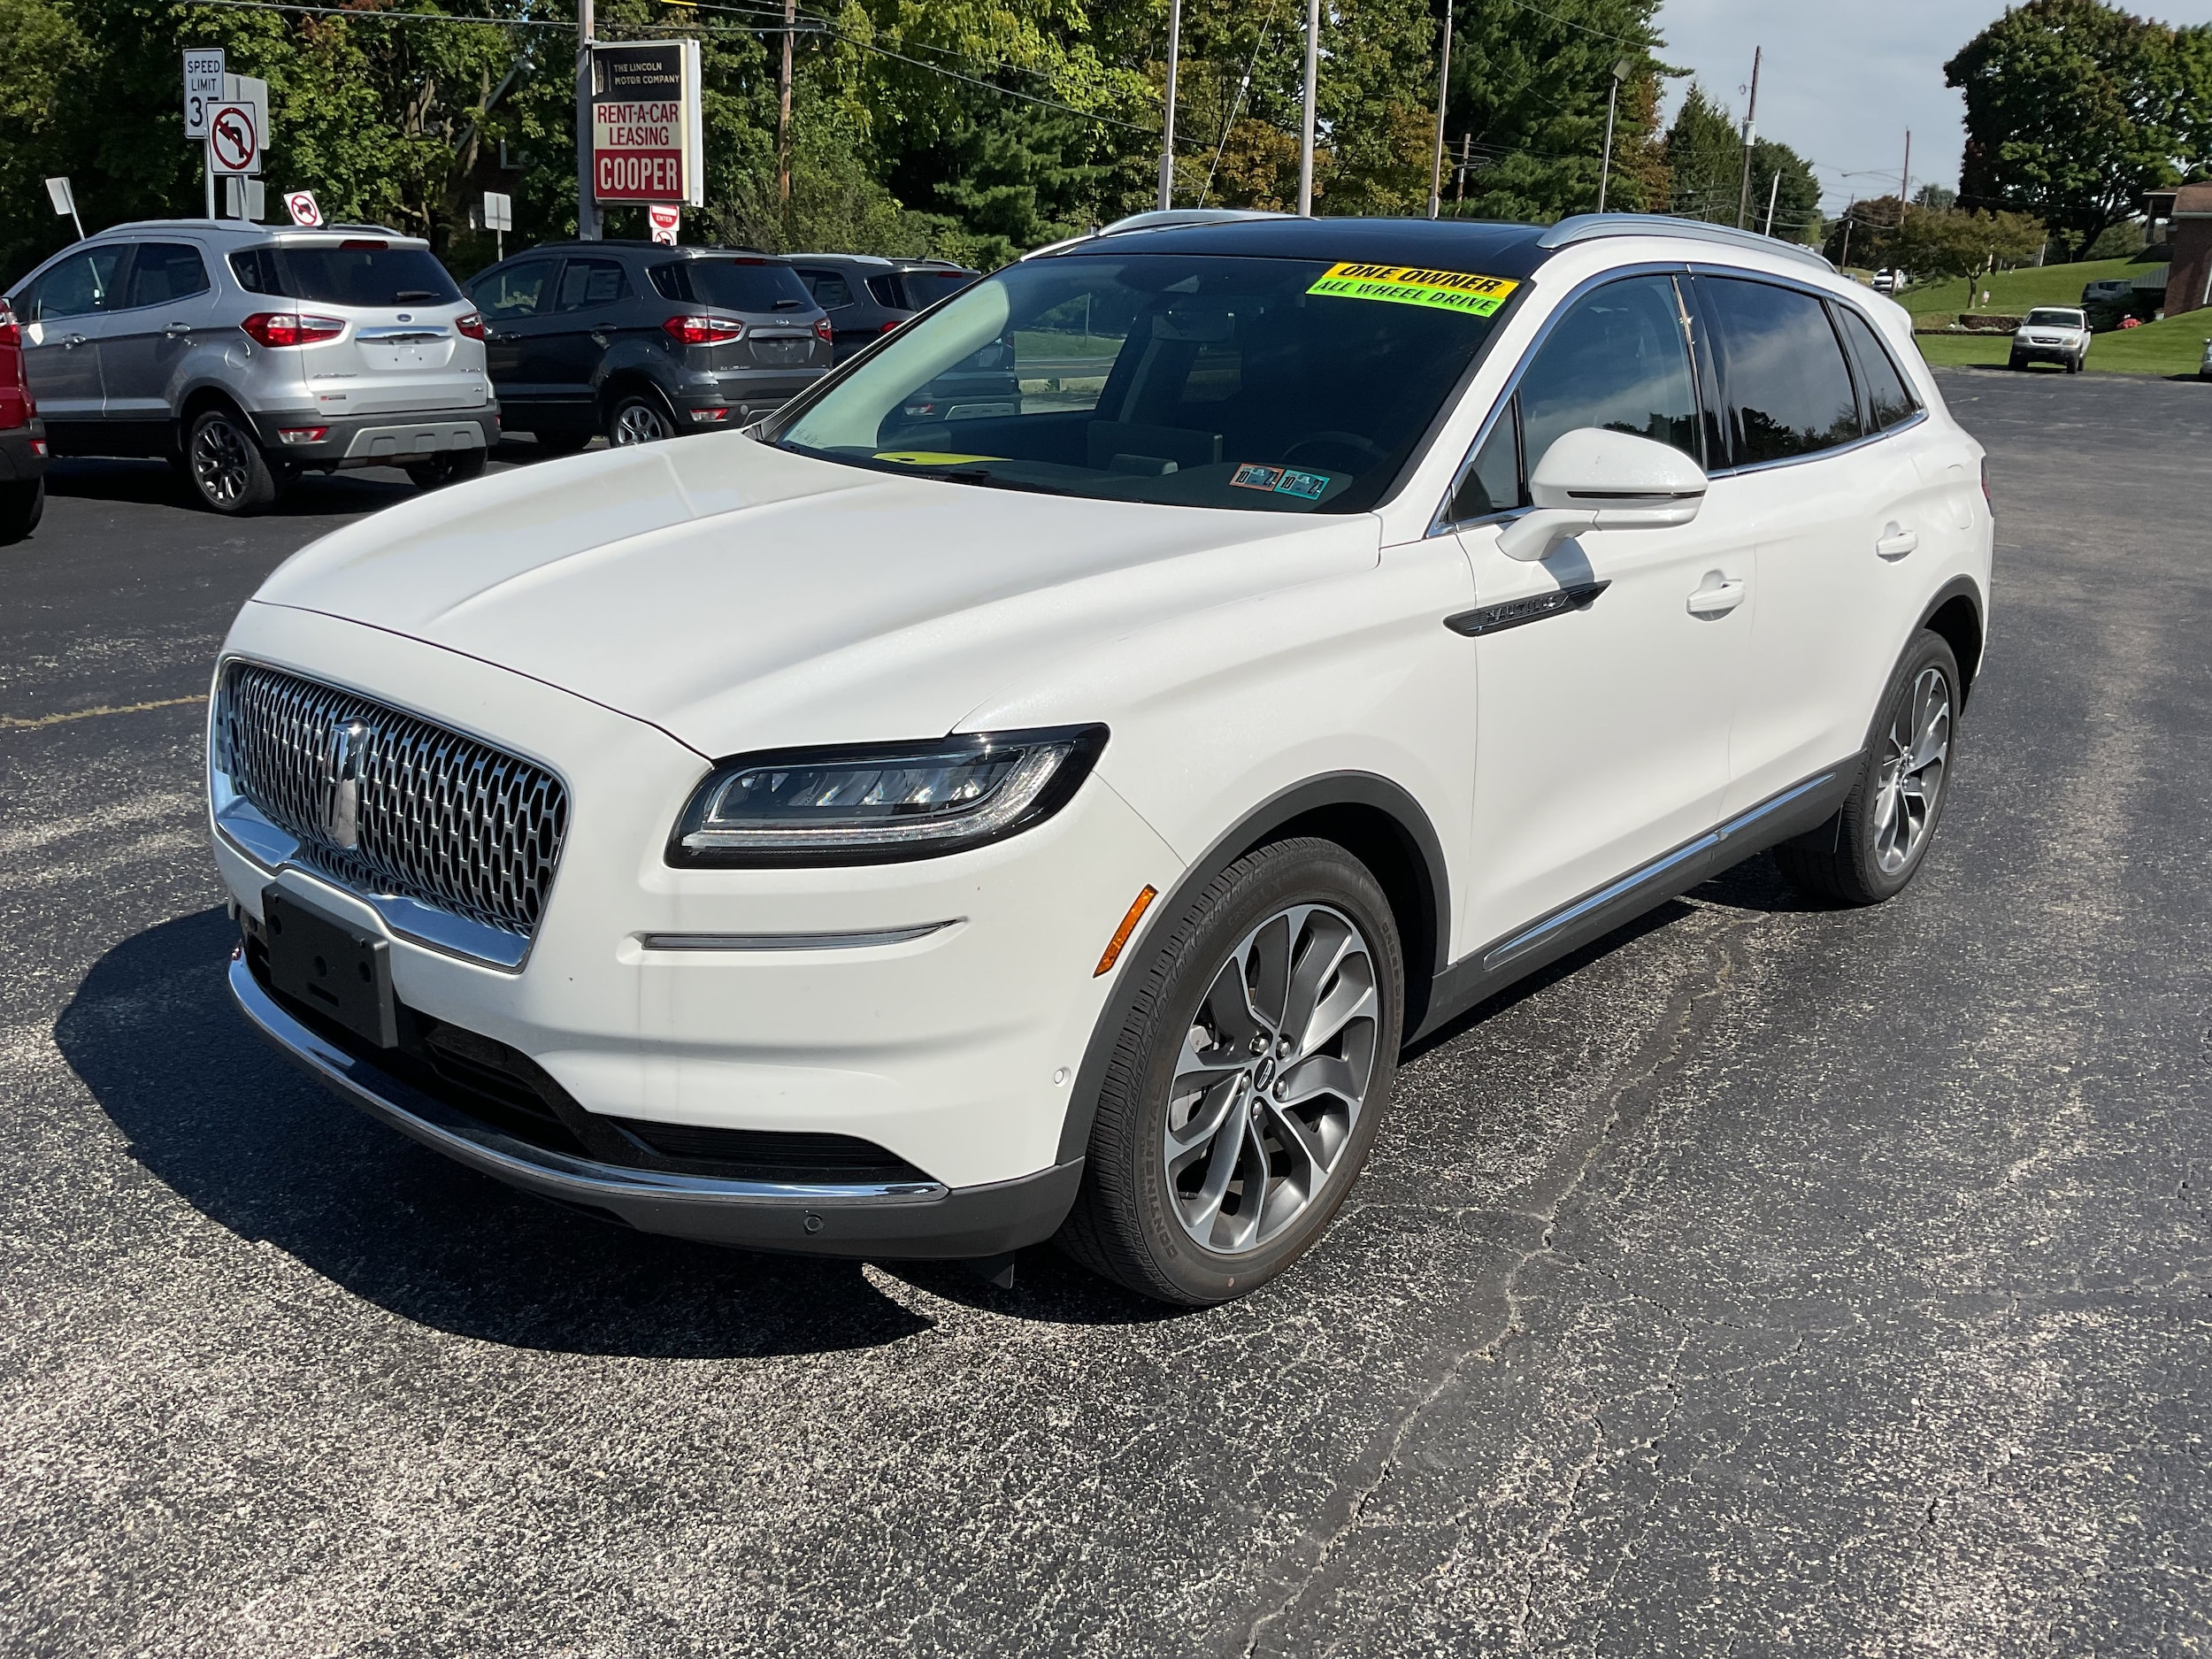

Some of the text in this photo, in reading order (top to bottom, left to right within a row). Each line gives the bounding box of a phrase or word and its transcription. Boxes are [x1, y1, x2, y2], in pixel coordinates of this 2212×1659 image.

[188, 60, 220, 73] SPEED
[613, 62, 663, 73] THE LINCOLN
[191, 78, 217, 91] LIMIT
[615, 73, 680, 85] MOTOR COMPANY
[189, 96, 219, 127] 3
[597, 103, 679, 124] RENT-A-CAR
[609, 126, 670, 146] LEASING
[600, 157, 678, 191] COOPER
[1338, 265, 1503, 293] ONE OWNER
[1315, 280, 1498, 312] ALL WHEEL DRIVE
[1235, 471, 1250, 483] 10
[1280, 475, 1296, 489] 10
[1147, 1083, 1179, 1261] CONTINENTAL
